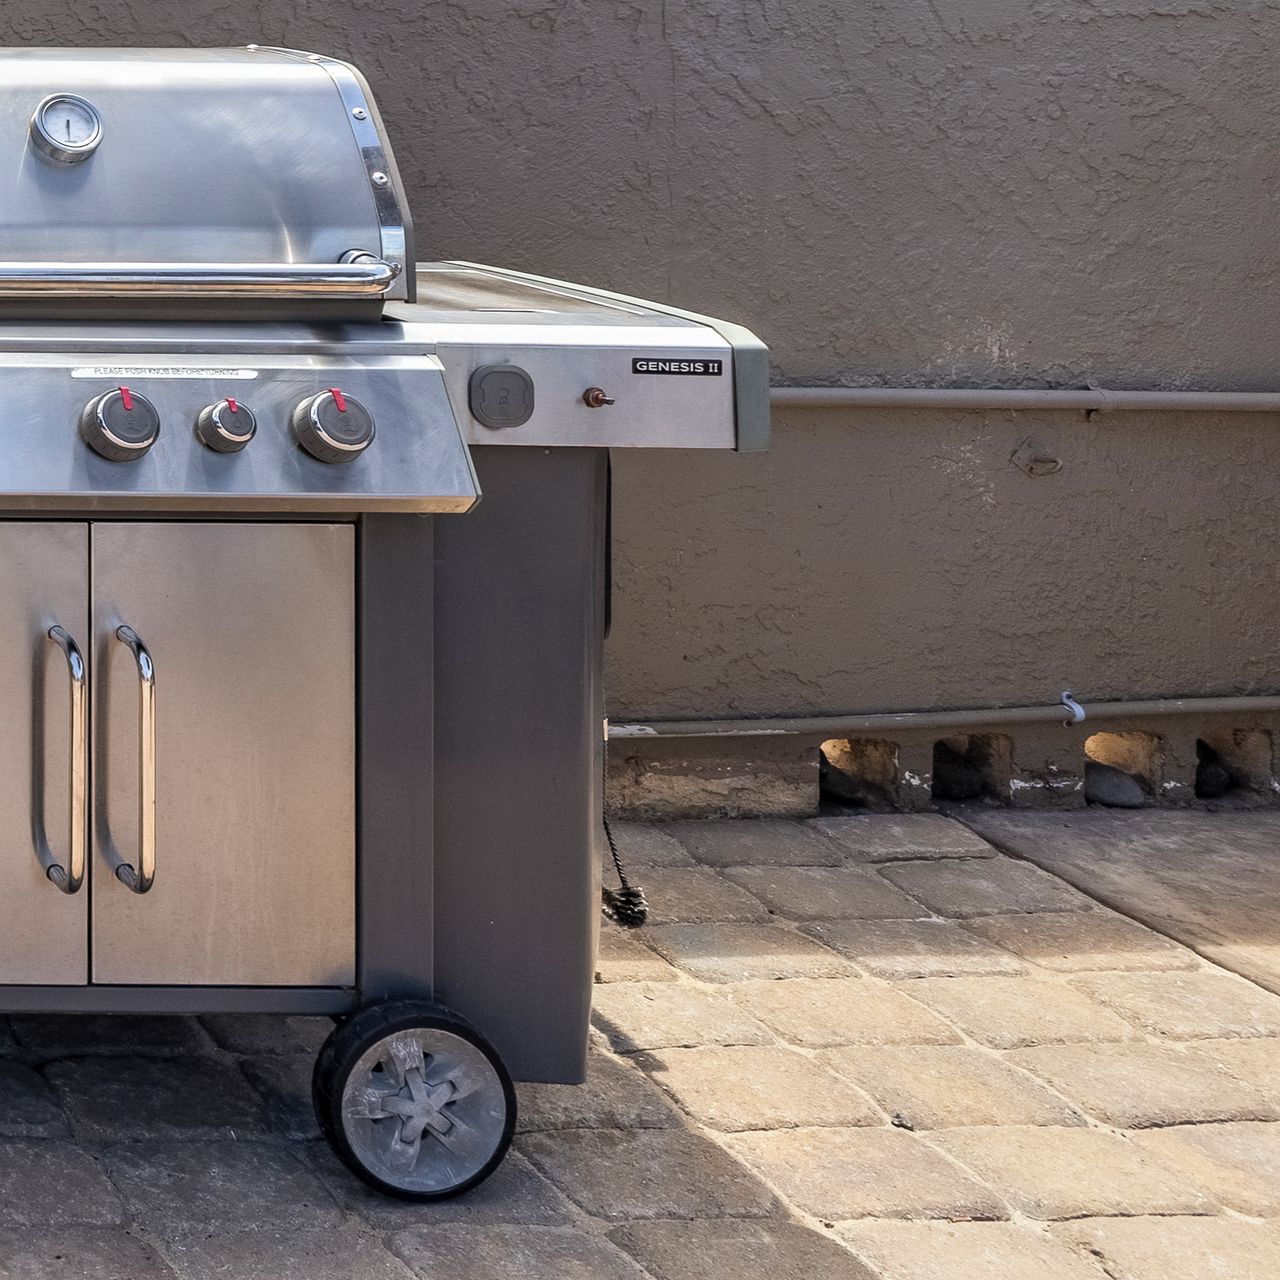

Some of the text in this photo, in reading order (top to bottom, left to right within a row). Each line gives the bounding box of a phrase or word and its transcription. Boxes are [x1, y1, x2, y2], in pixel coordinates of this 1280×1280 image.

[94, 367, 123, 375] PLEASE
[636, 361, 719, 373] GENESIS II
